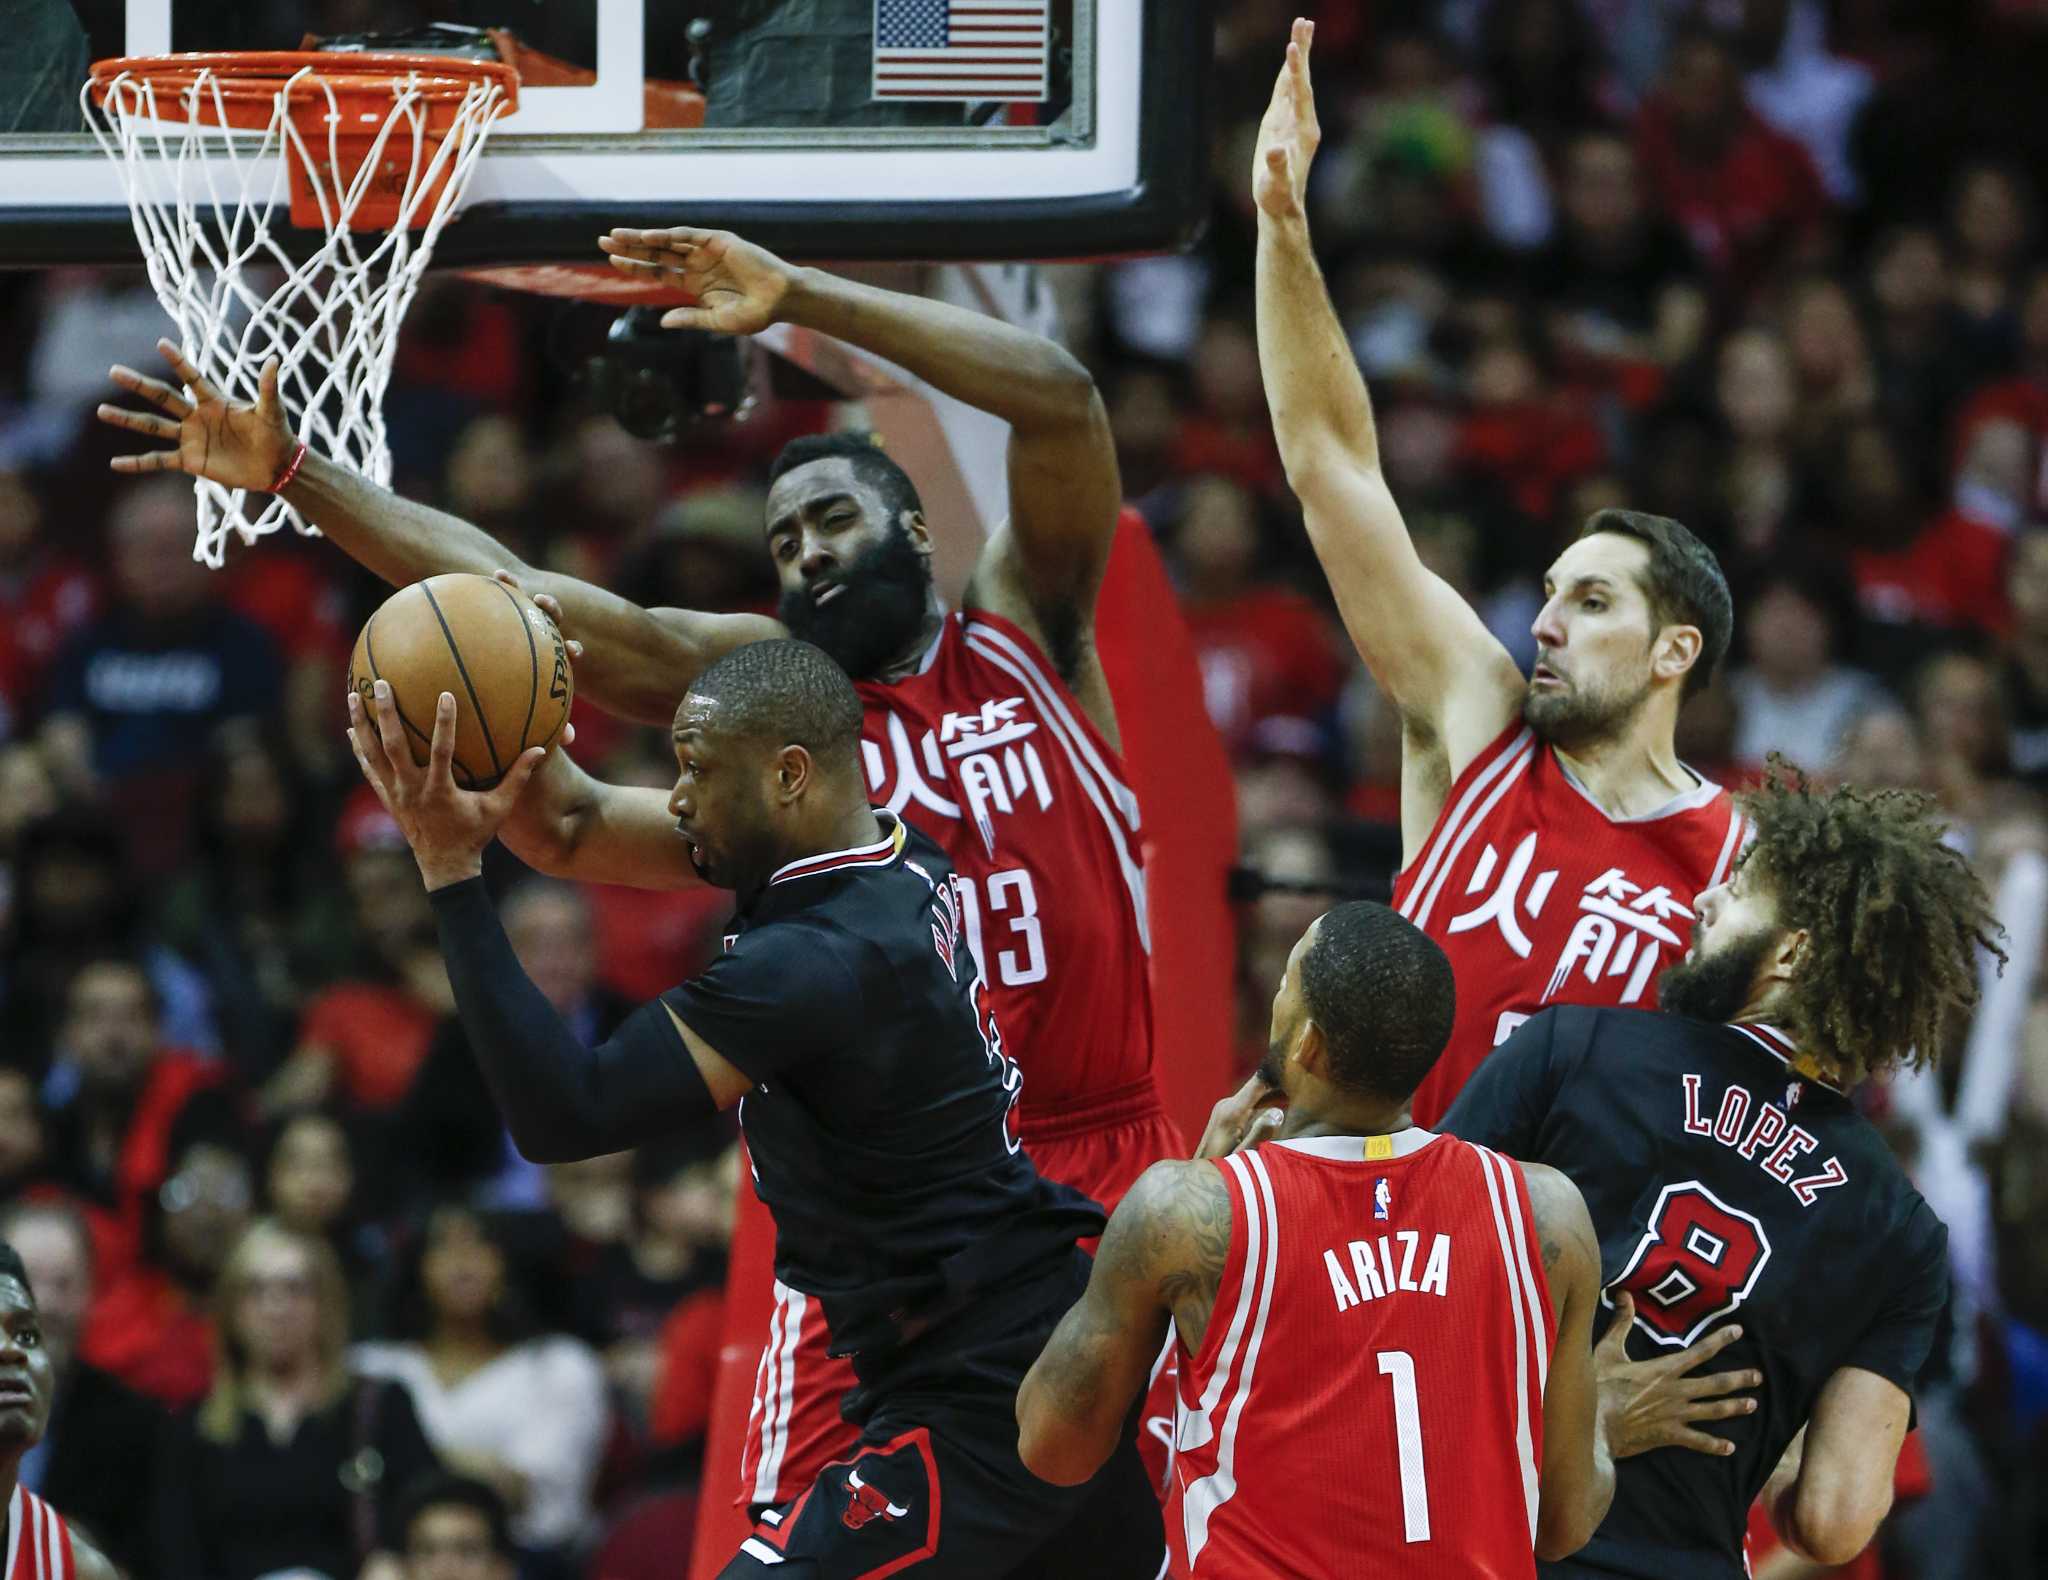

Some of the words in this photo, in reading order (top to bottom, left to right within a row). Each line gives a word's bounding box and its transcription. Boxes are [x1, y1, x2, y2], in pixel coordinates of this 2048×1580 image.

[1447, 832, 1696, 1004] 火箭
[1682, 1073, 1849, 1207] LOPEZ
[1322, 1231, 1451, 1312] ARIZA
[1601, 1180, 1772, 1348] 8
[1376, 1350, 1432, 1544] 1
